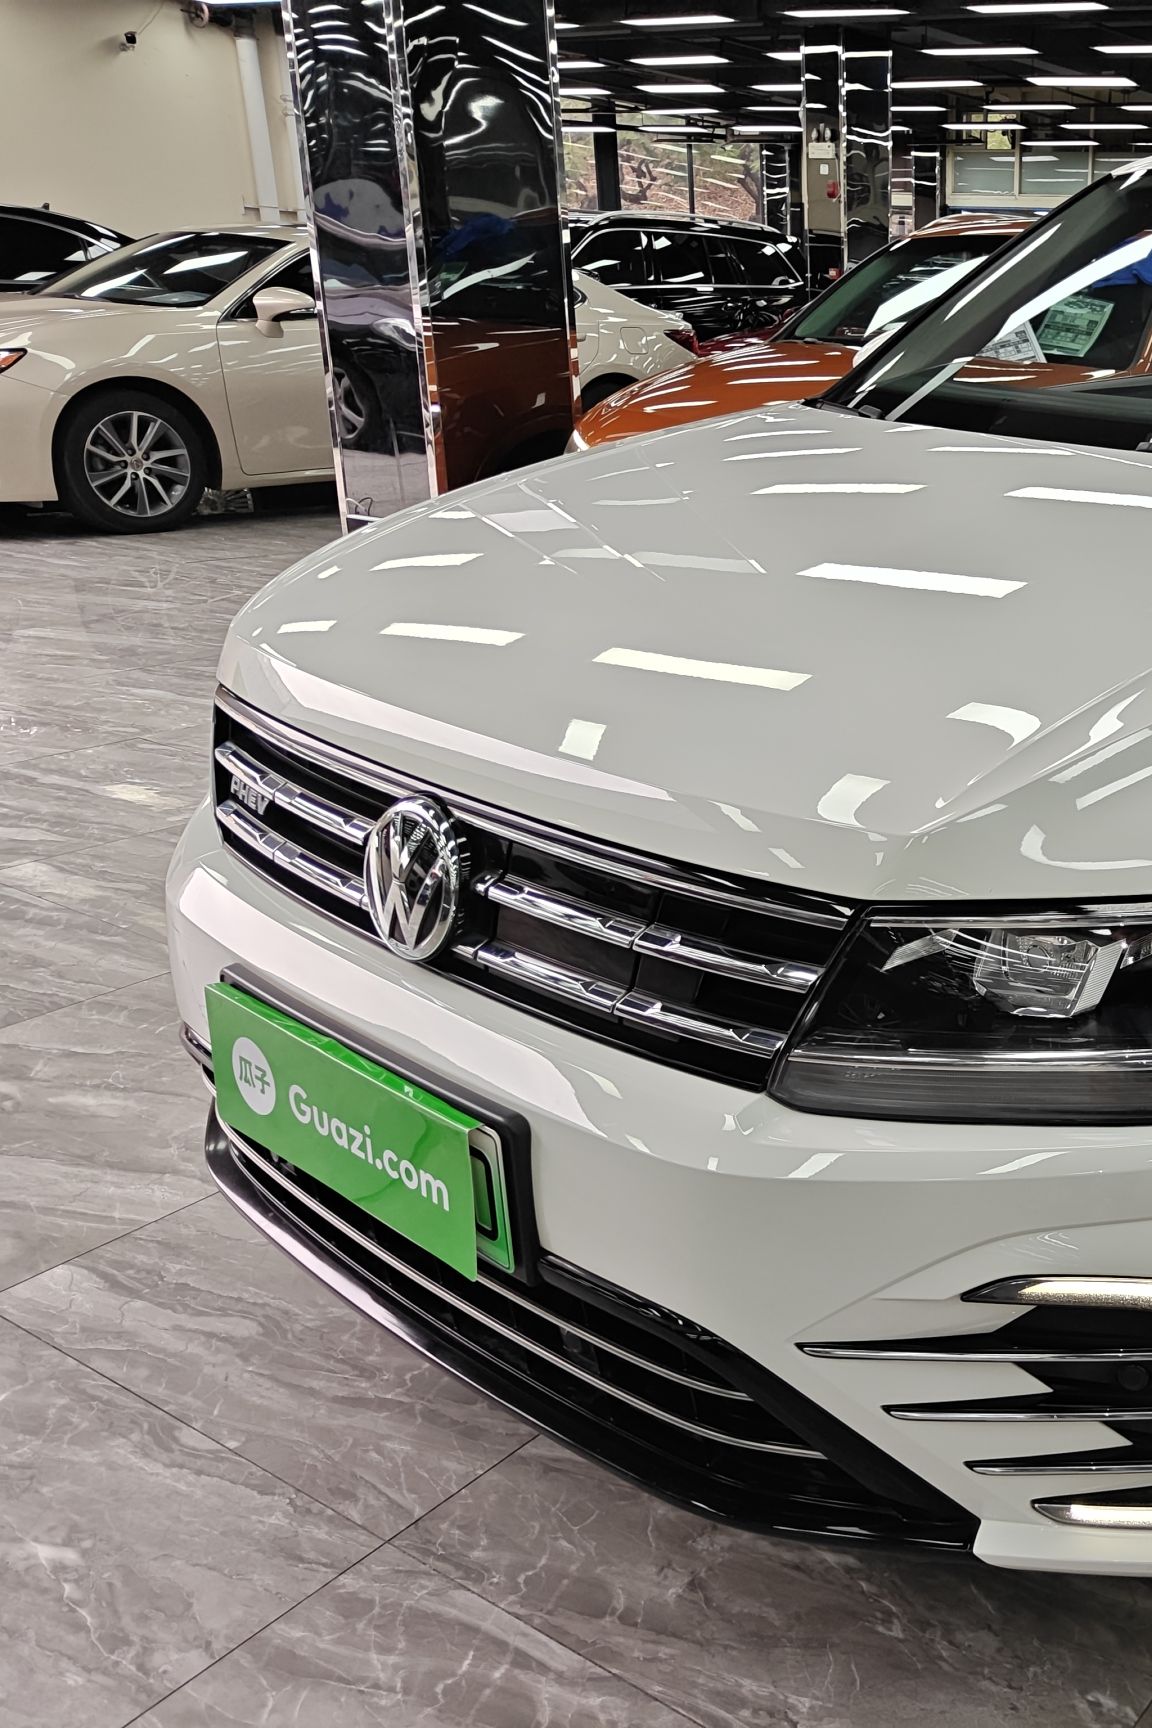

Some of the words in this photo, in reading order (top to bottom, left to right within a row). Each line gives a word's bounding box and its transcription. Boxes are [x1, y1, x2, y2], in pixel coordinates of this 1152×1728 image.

[231, 775, 270, 815] PHEV
[238, 1055, 271, 1095] 瓜子
[288, 1084, 450, 1212] Guazi.com
